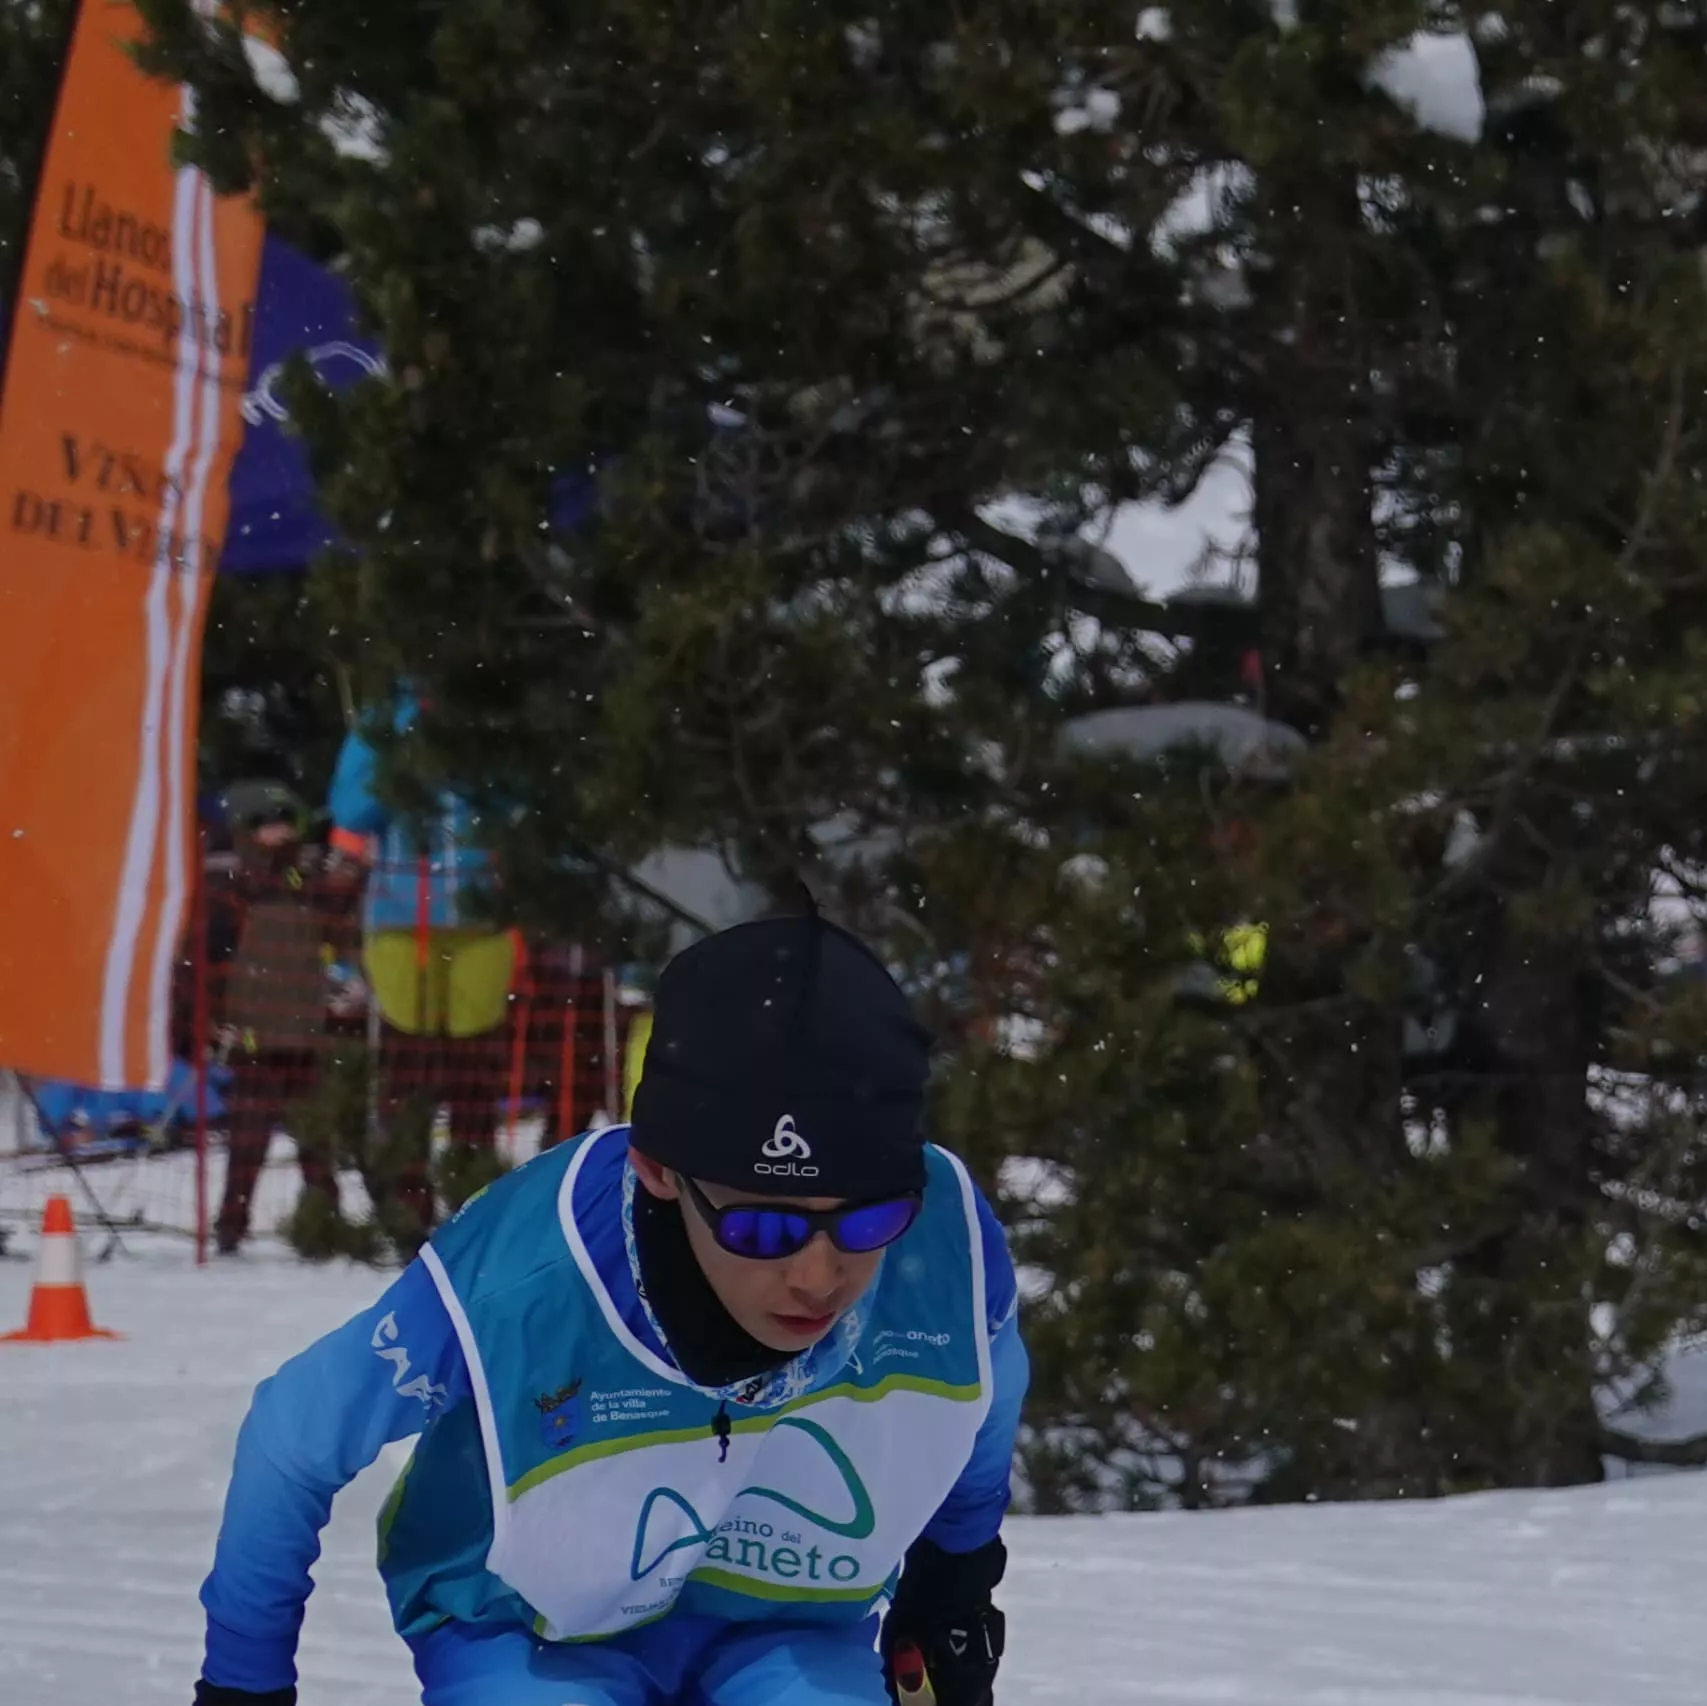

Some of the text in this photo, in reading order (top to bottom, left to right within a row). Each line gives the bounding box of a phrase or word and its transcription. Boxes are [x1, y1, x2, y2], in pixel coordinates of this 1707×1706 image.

[754, 1162, 820, 1177] odlo
[590, 1387, 673, 1402] Ayuntamiento
[591, 1398, 647, 1412] de la villa
[592, 1409, 671, 1423] de Benasque
[781, 1530, 802, 1545] del
[705, 1536, 860, 1582] aneto
